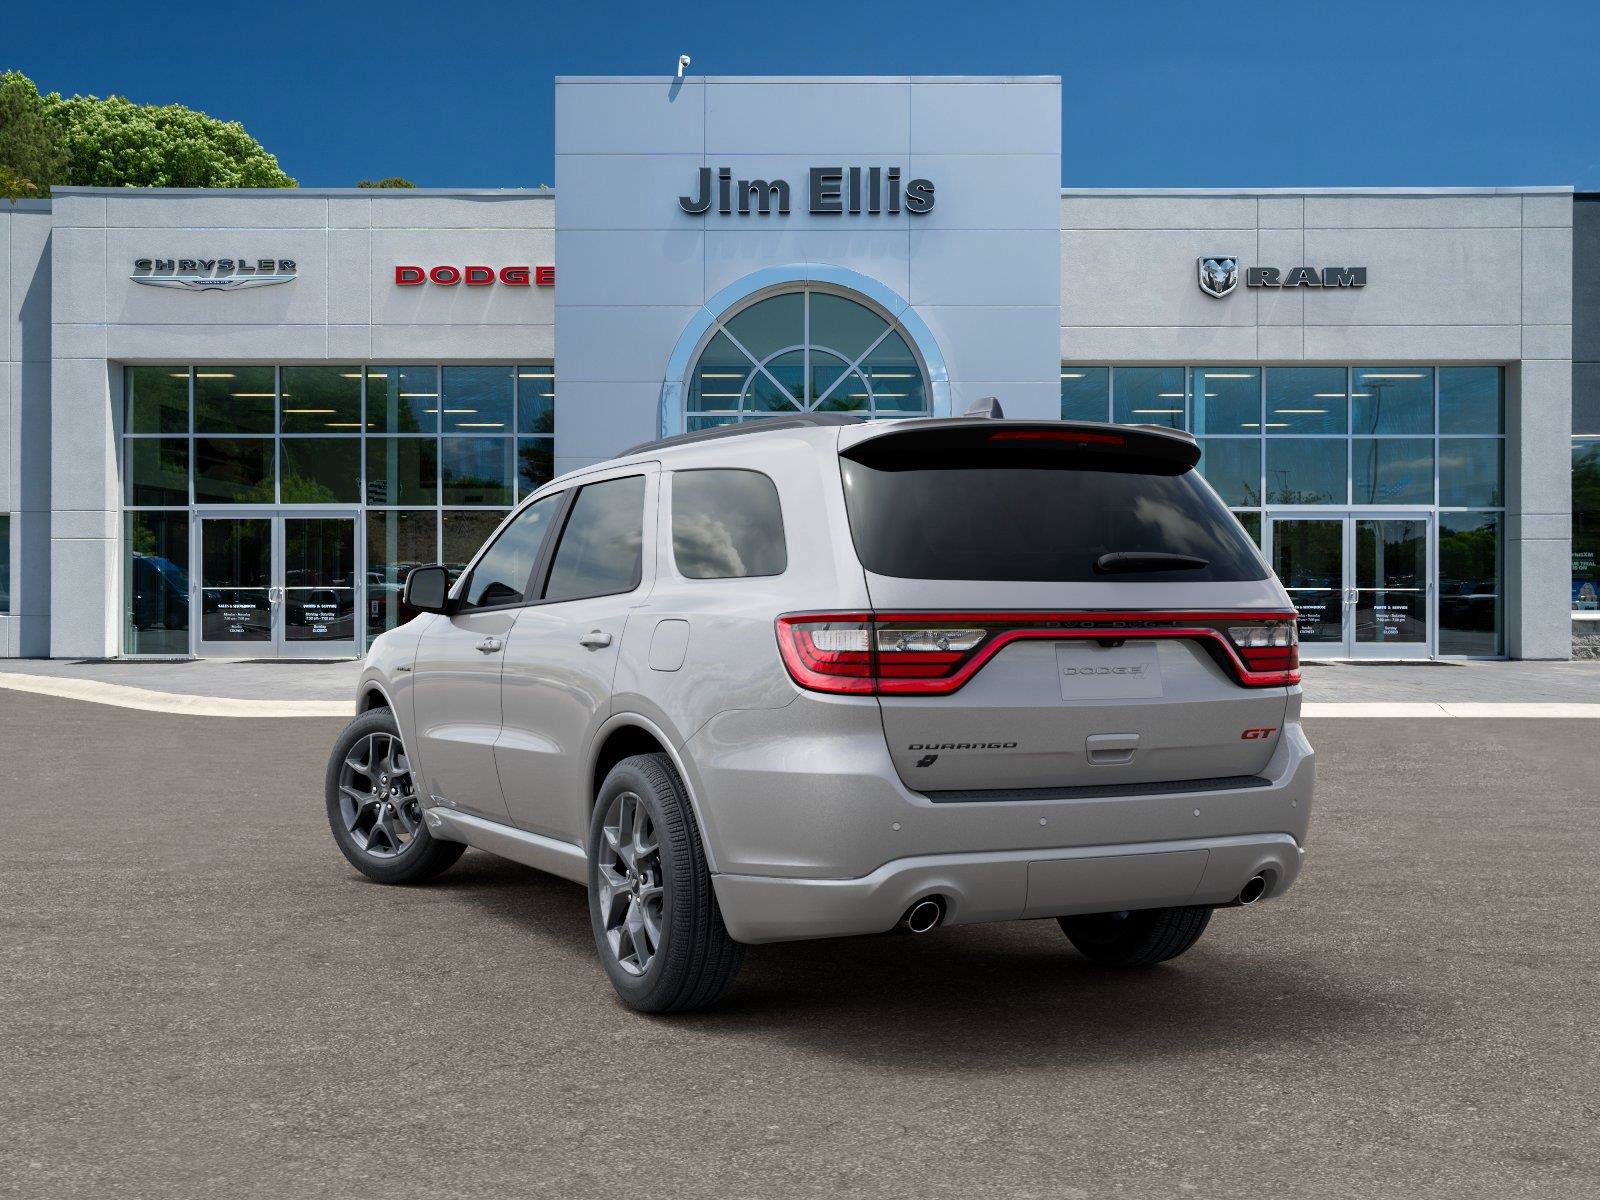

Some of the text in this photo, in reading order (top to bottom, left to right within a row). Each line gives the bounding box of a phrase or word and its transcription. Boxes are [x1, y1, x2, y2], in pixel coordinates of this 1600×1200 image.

[679, 167, 935, 214] Jim Ellis
[134, 258, 297, 271] CHRYSLER
[395, 265, 555, 286] DODGE
[1247, 266, 1367, 287] RAM
[1063, 666, 1145, 676] DODGE
[1241, 727, 1277, 740] GT
[908, 742, 1018, 751] DURANGO
